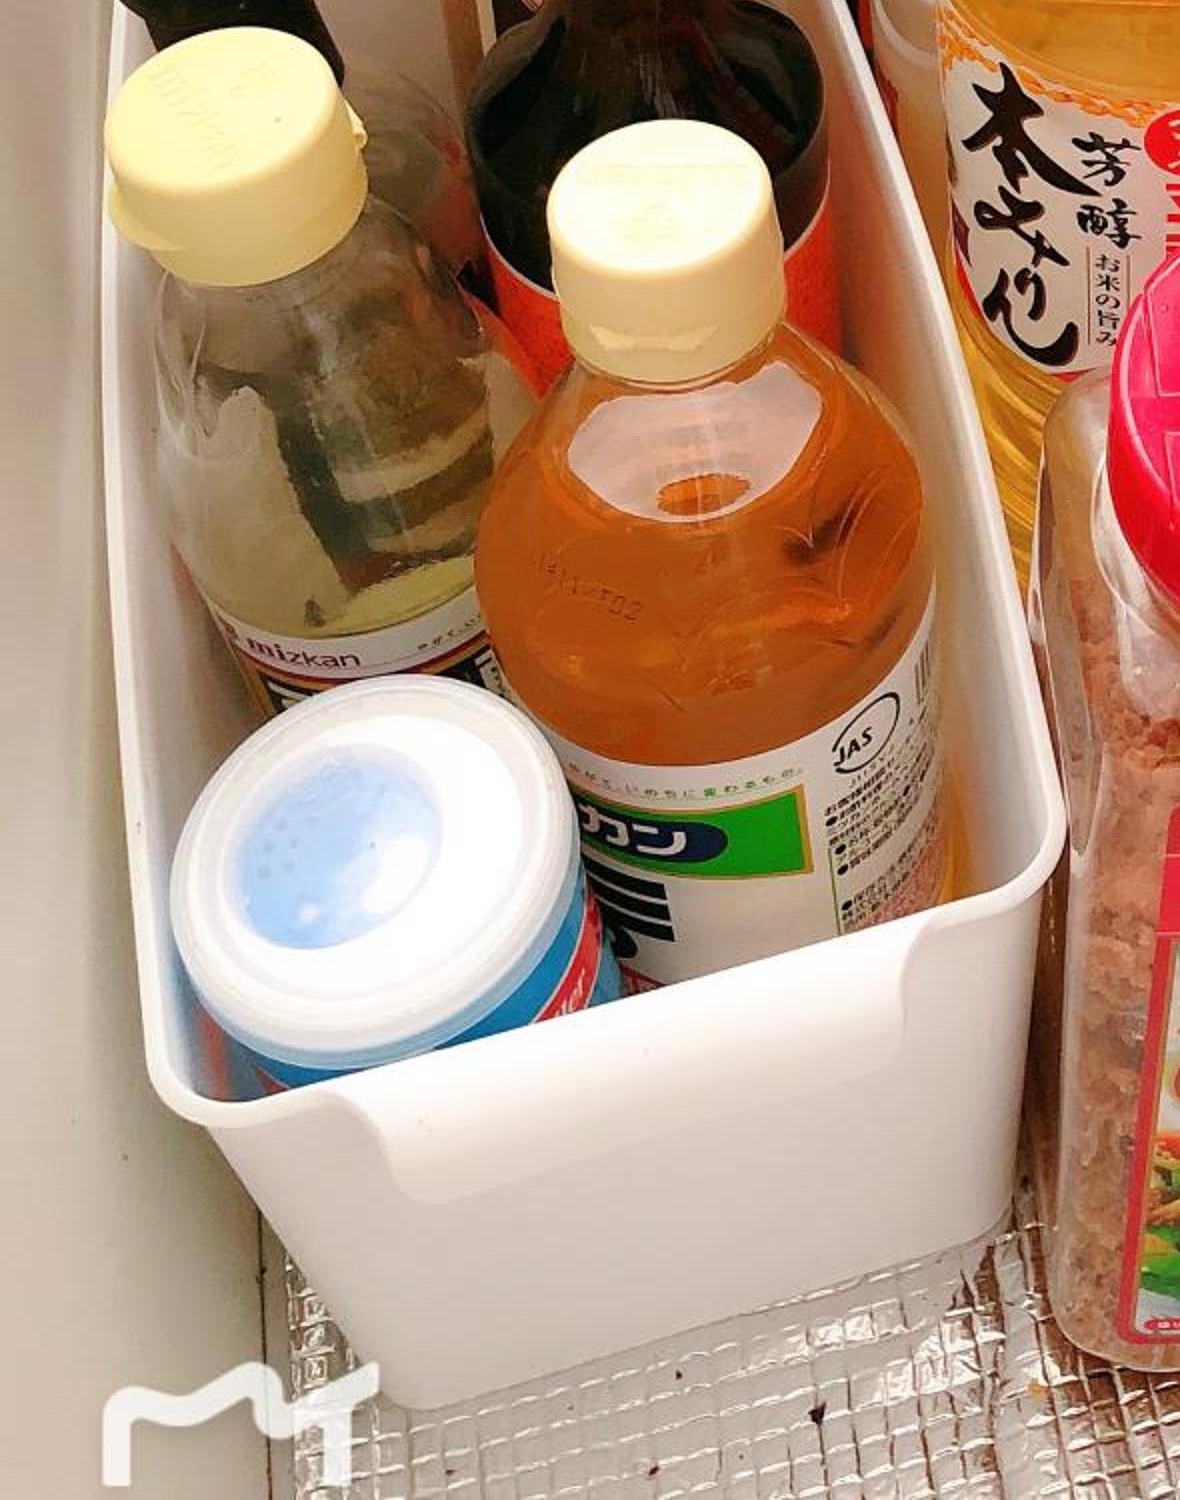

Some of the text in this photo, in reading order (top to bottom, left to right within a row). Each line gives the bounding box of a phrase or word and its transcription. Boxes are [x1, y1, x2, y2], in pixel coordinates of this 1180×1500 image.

[961, 61, 1102, 367] 本みりん
[1071, 130, 1143, 250] 芳醇
[1095, 253, 1121, 347] お米の旨み
[246, 636, 361, 668] mizkan
[833, 725, 873, 767] JAS
